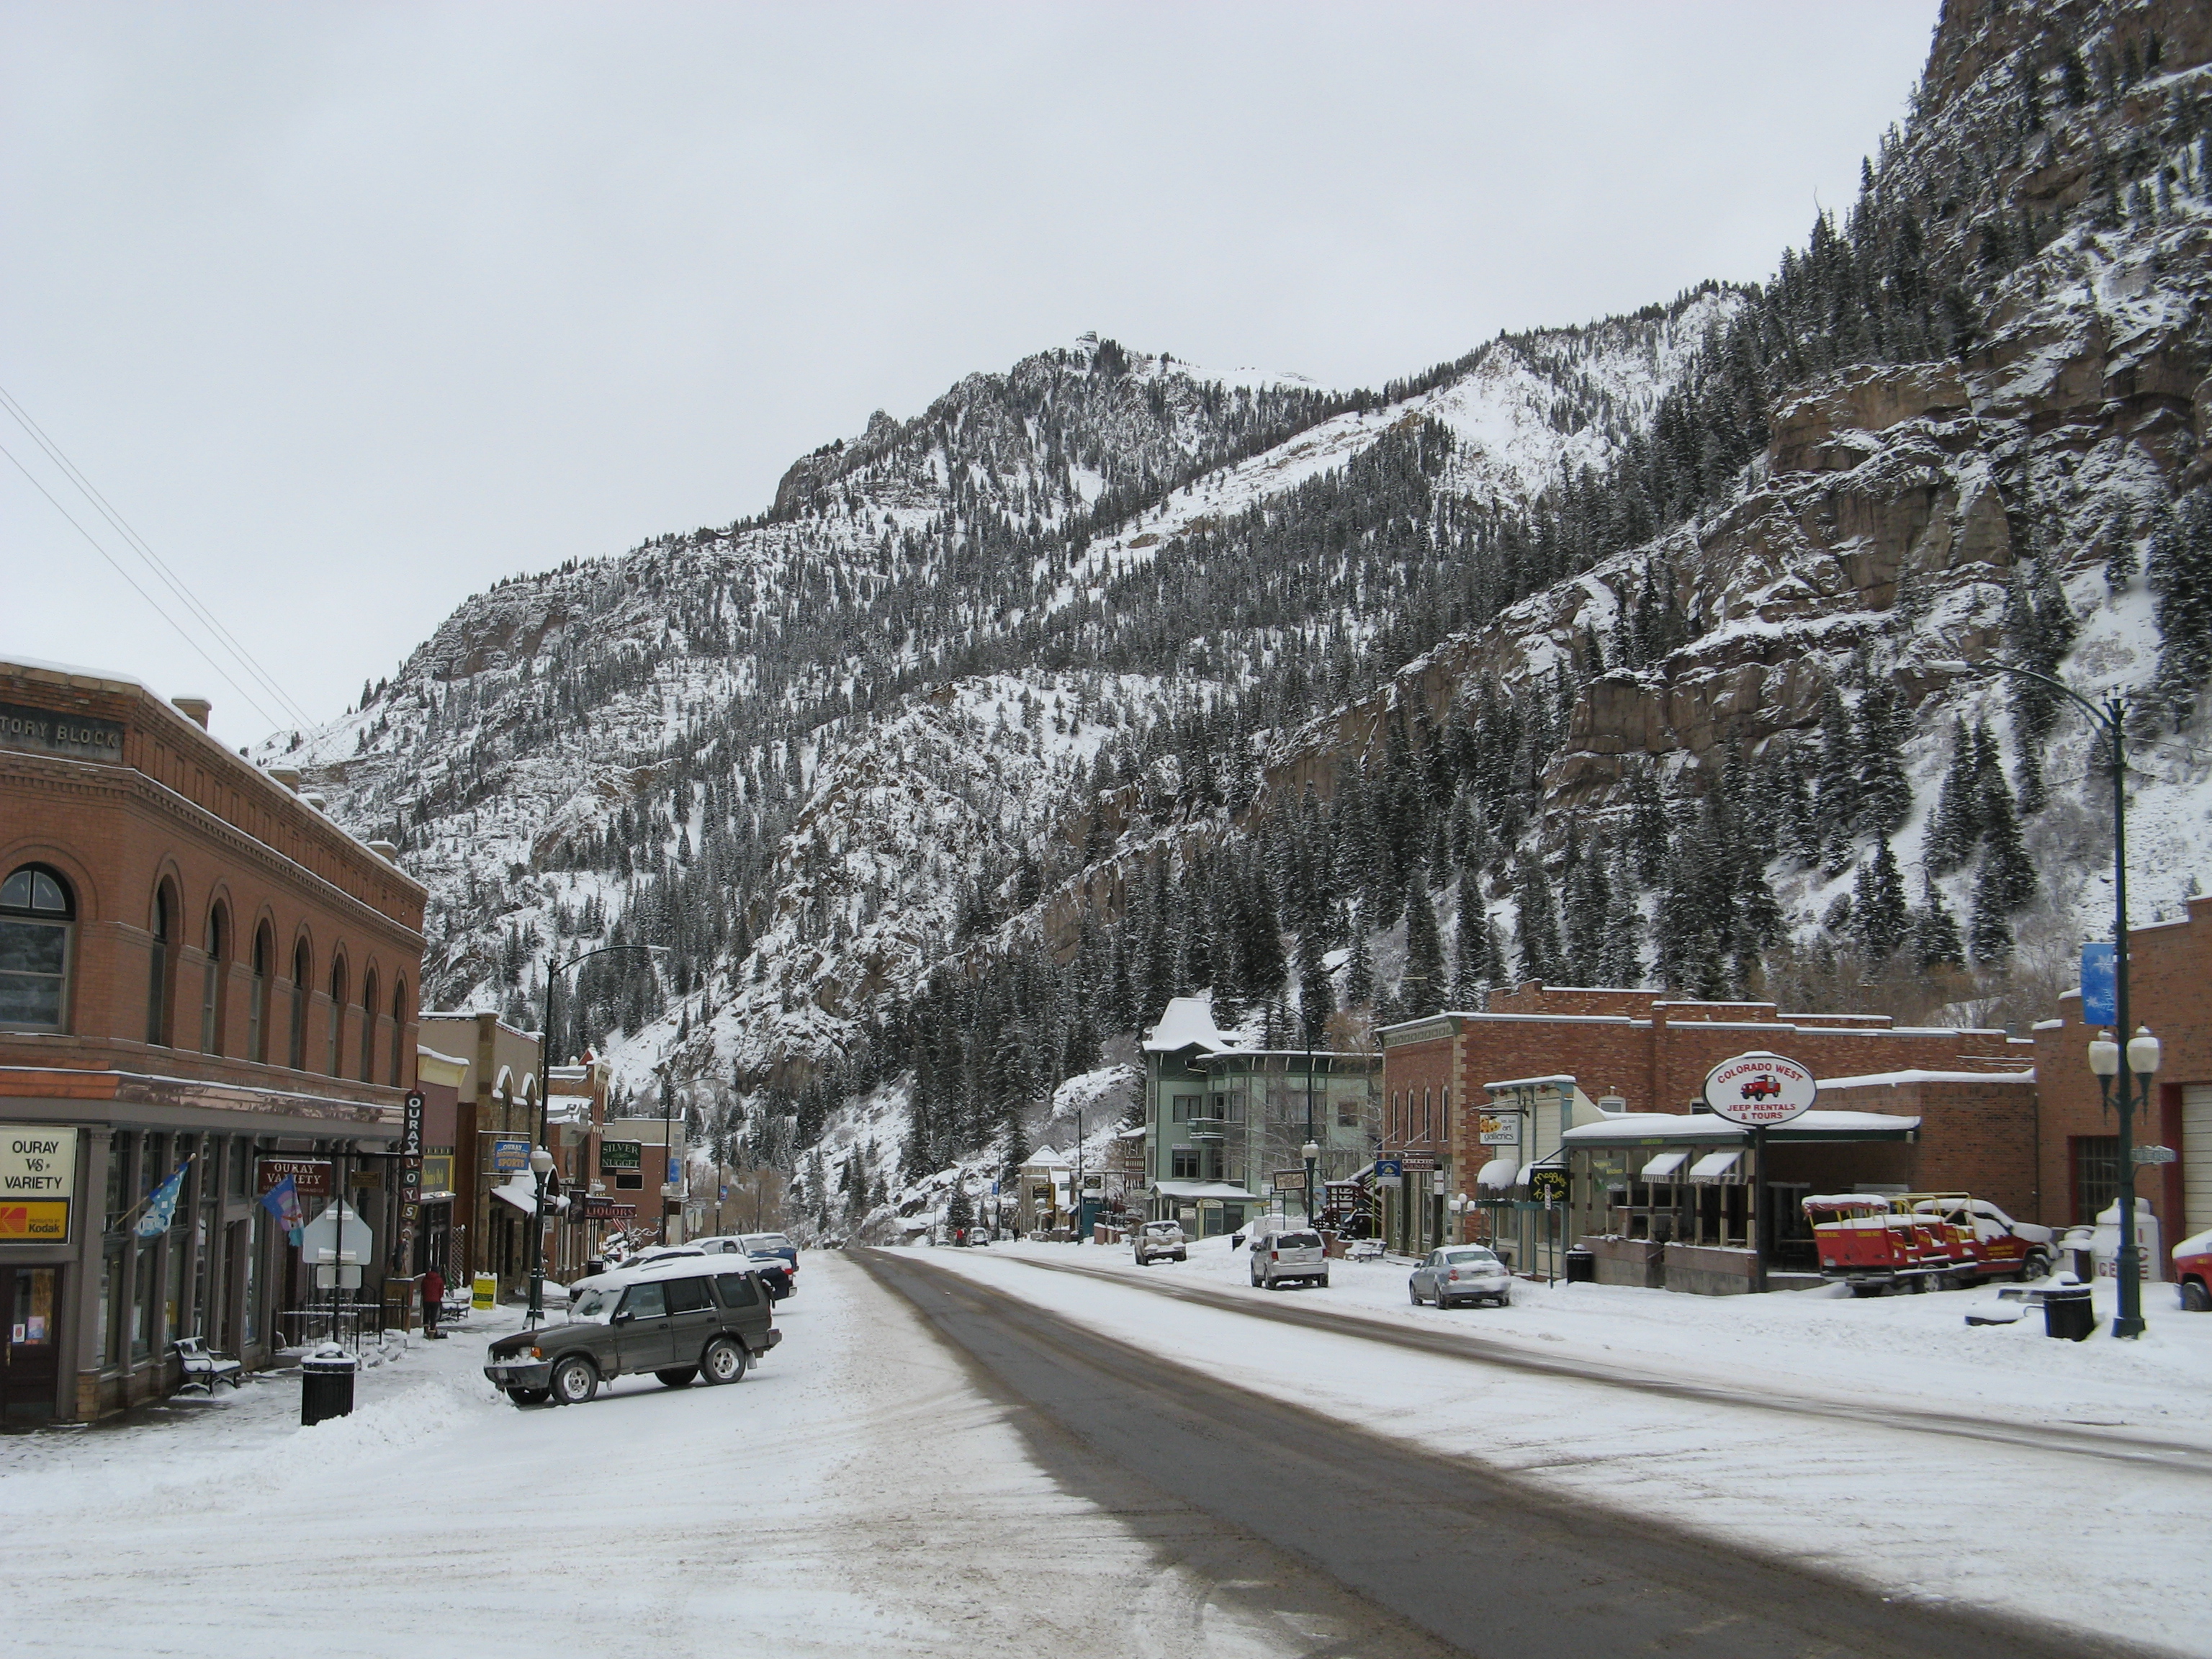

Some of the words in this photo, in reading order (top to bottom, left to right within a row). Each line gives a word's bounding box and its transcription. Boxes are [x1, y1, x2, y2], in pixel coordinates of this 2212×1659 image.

[57, 725, 116, 748] BLOCK
[1717, 1063, 1772, 1083] COLORADO
[1776, 1064, 1803, 1082] WEST
[408, 1098, 421, 1151] OURAY
[12, 1141, 59, 1154] OURAY
[603, 1143, 639, 1156] SILVER
[274, 1163, 315, 1174] OURAY
[602, 1158, 639, 1168] NUGGET
[5, 1176, 63, 1189] VARIETY
[267, 1173, 321, 1184] VAIETY
[587, 1207, 634, 1216] LIQUORS
[29, 1223, 60, 1233] Kodak
[2093, 1262, 2117, 1278] ICE
